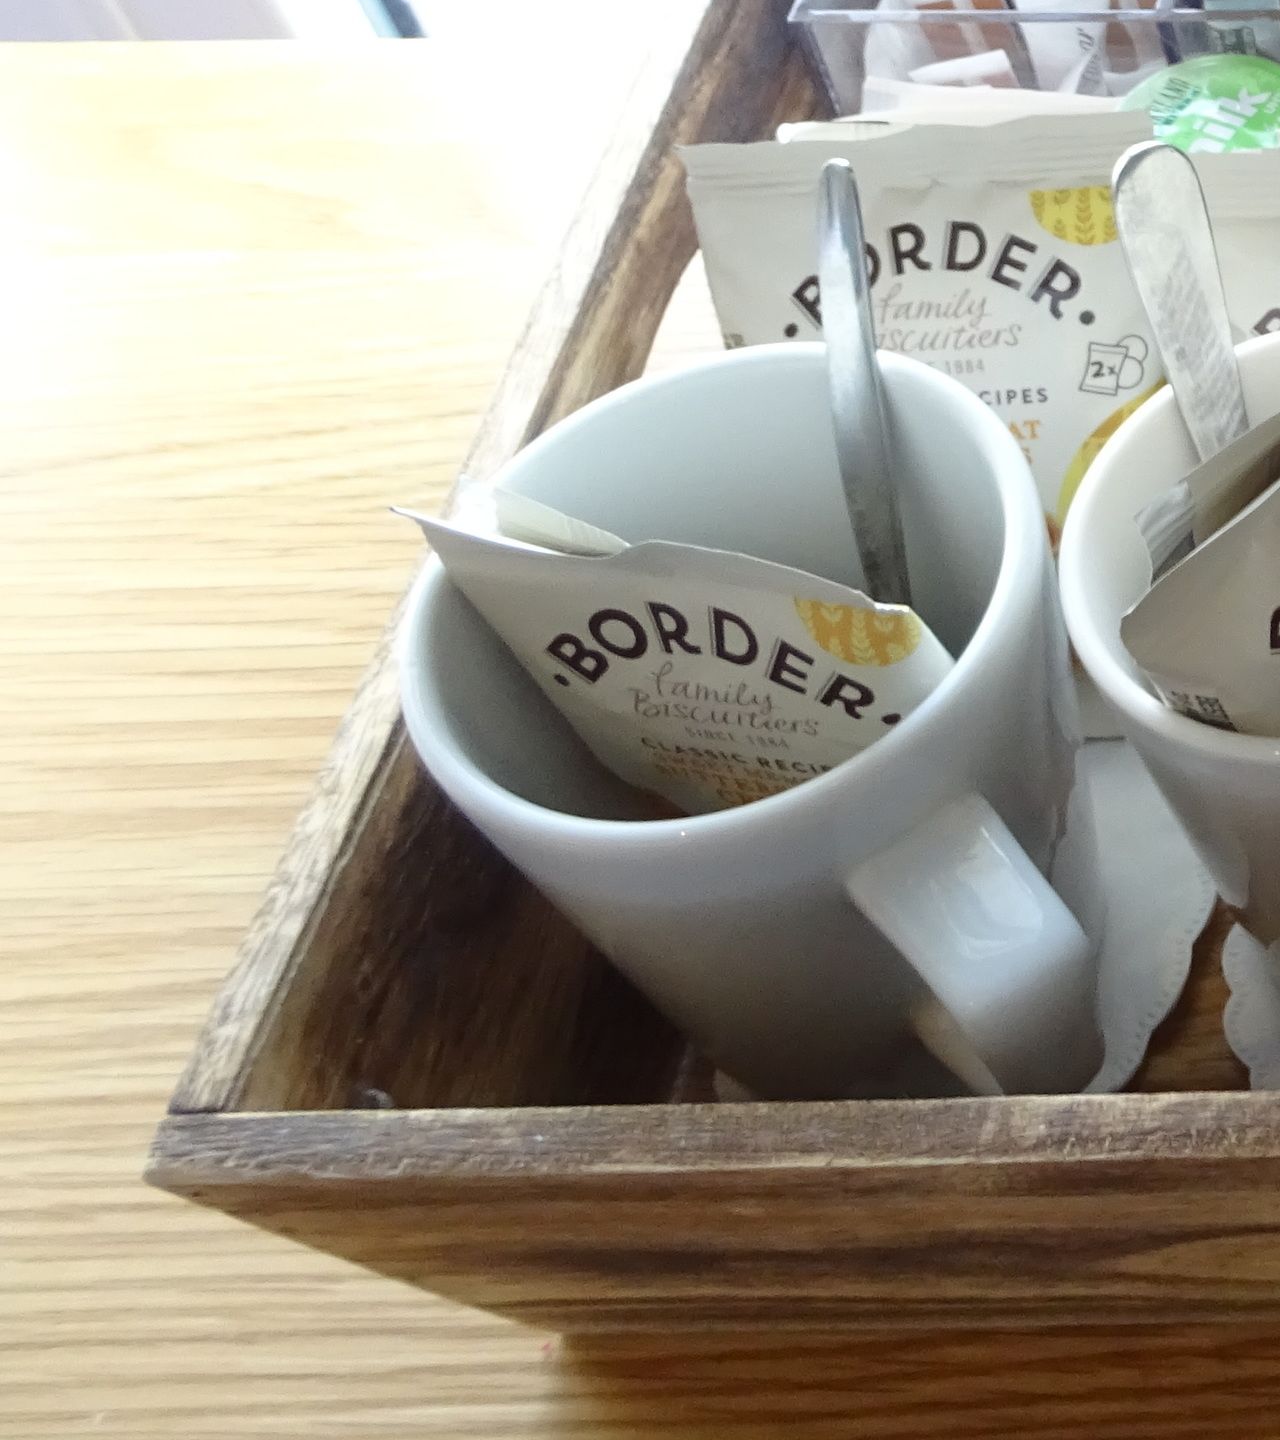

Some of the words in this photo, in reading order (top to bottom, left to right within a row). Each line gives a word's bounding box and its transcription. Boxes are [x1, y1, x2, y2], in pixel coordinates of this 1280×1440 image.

[876, 281, 989, 329] family
[878, 322, 1022, 352] iscuitiers
[546, 600, 876, 720] BORDER
[651, 662, 776, 713] family
[640, 737, 747, 764] CLASSIC
